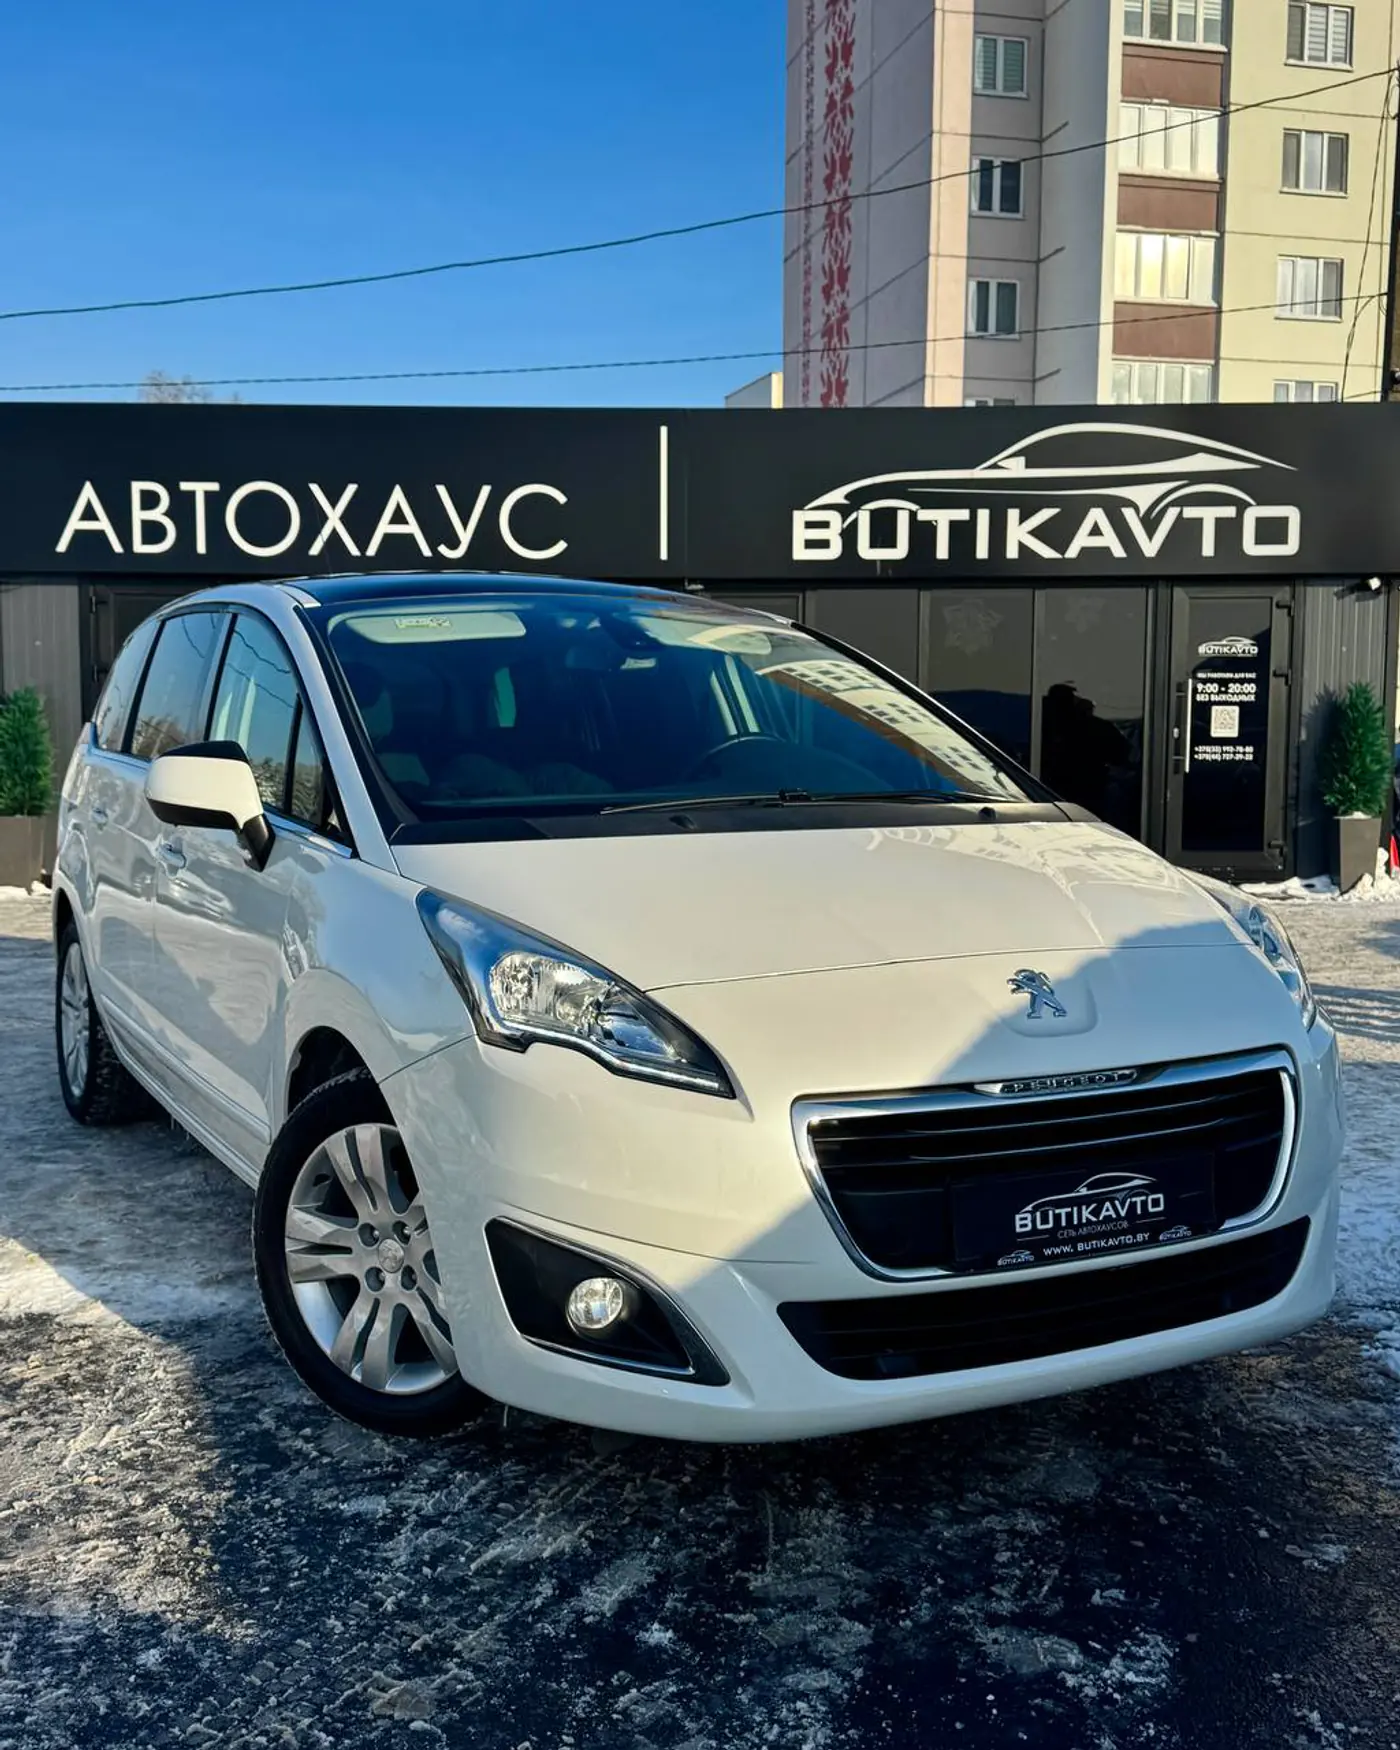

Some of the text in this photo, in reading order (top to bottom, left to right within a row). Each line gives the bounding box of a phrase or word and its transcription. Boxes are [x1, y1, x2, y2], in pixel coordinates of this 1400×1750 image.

[55, 480, 570, 560] АВТОХАУС
[791, 504, 1301, 561] BUTIKAVTO
[1197, 645, 1259, 655] BUTIKAVTO
[1196, 683, 1219, 693] 9:00
[1227, 683, 1257, 693] 20:00
[1015, 1193, 1165, 1233] BUTIKAVTO
[1057, 1220, 1129, 1239] СЕТЬ АВТОХАУСОВ
[1043, 1232, 1150, 1257] WWW. BUTIKAVTO.BY
